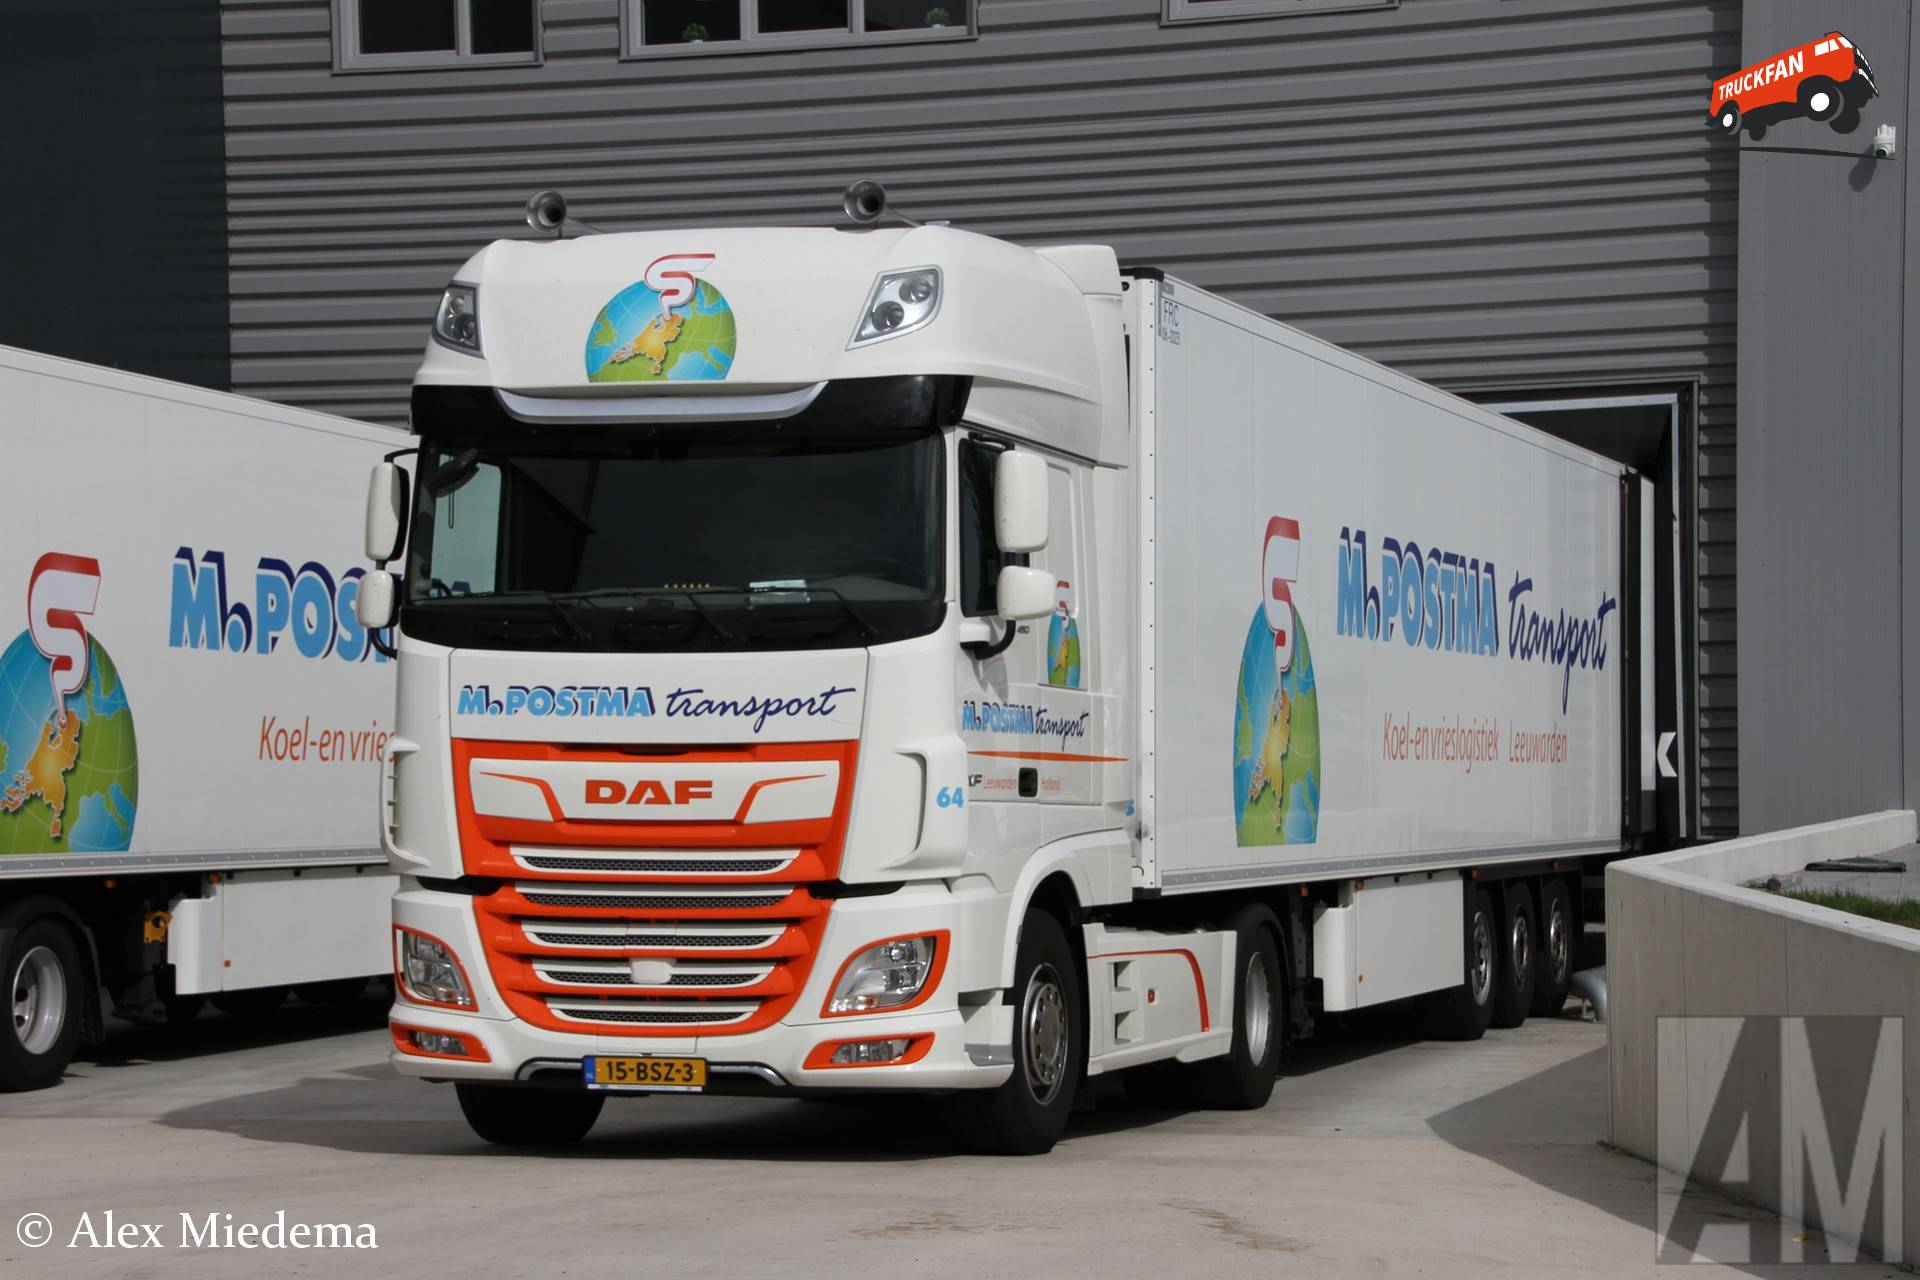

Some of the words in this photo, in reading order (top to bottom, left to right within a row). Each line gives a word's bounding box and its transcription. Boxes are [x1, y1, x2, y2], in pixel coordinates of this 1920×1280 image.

[1508, 569, 1616, 716] transport
[665, 686, 857, 734] transport
[1034, 706, 1090, 752] transport
[1508, 719, 1568, 763] Leeuwarden
[584, 779, 713, 805] DAF
[935, 786, 965, 809] 64
[605, 1060, 694, 1083] 15-BSZ-3
